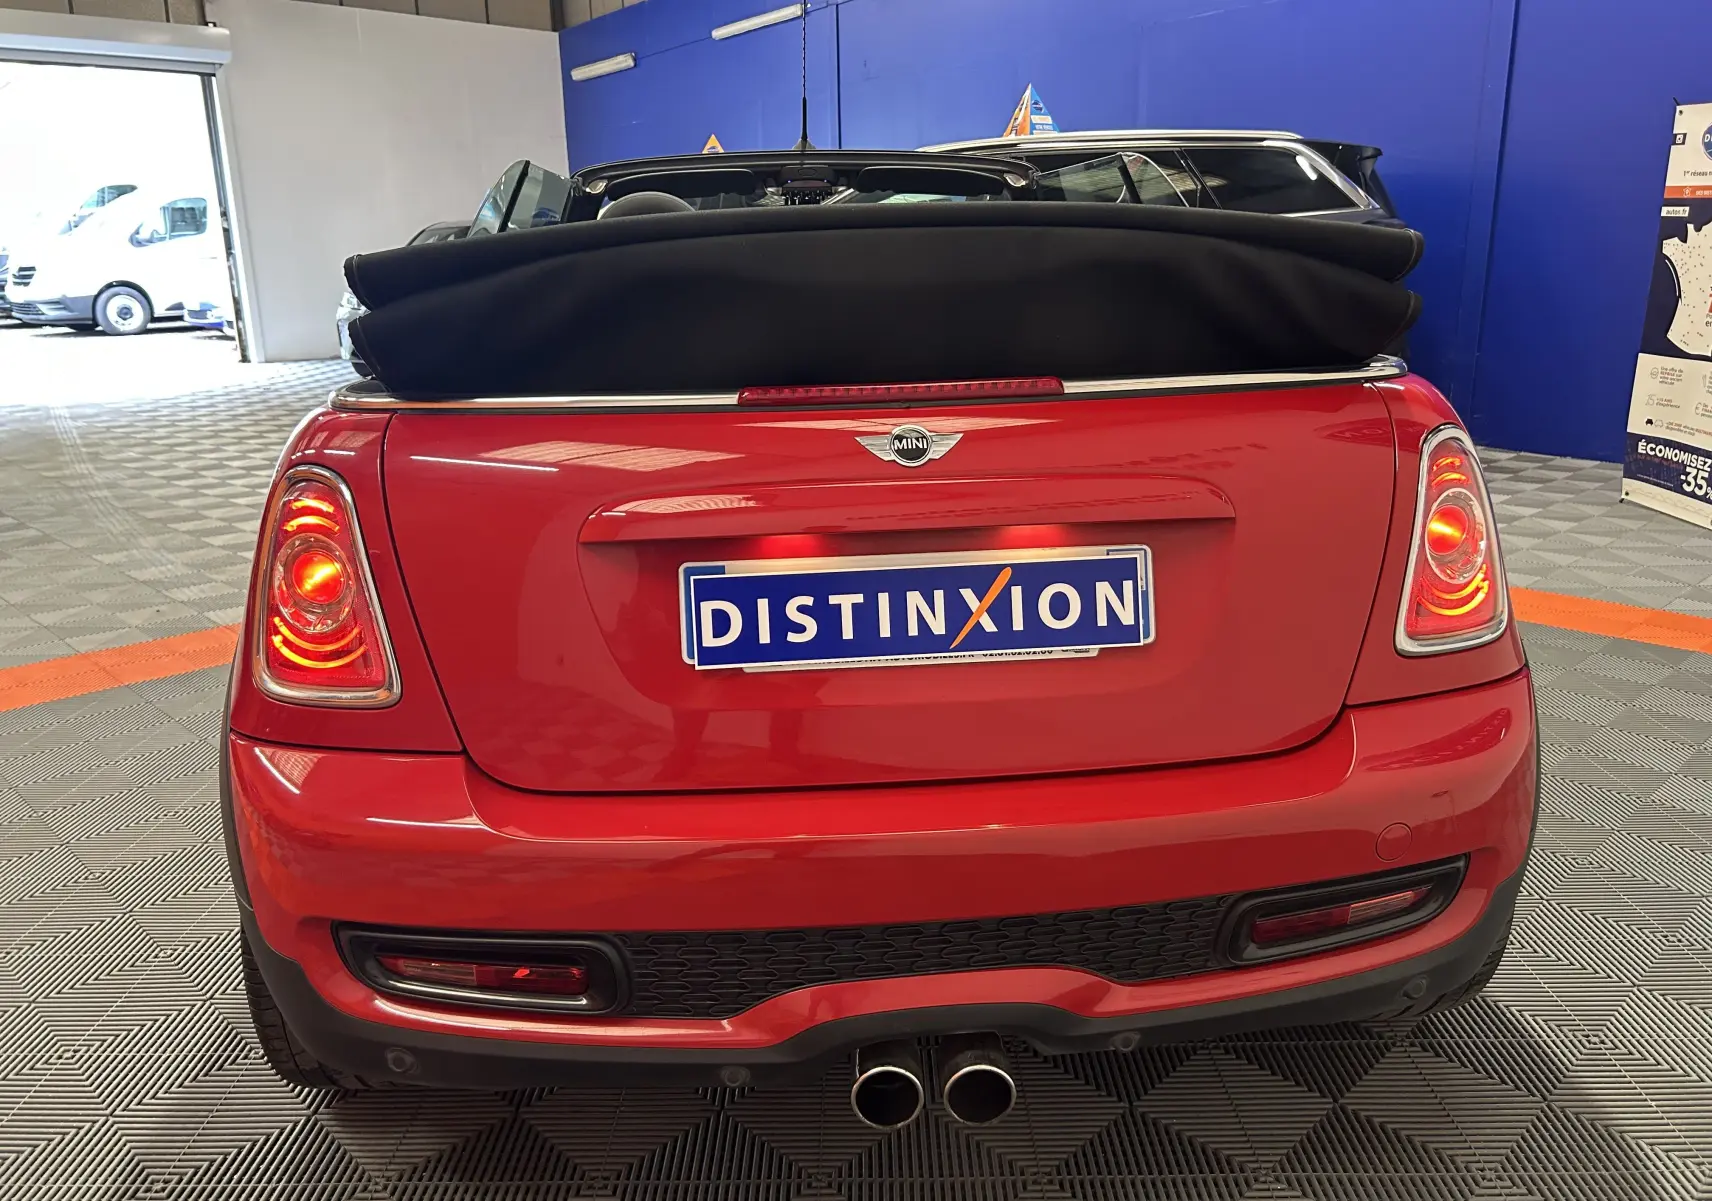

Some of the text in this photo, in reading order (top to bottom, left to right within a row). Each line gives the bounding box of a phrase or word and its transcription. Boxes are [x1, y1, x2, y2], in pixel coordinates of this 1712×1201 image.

[894, 438, 928, 450] MINI
[1637, 439, 1712, 472] ÉCONOMISEZ
[699, 567, 1136, 648] DISTINXION
